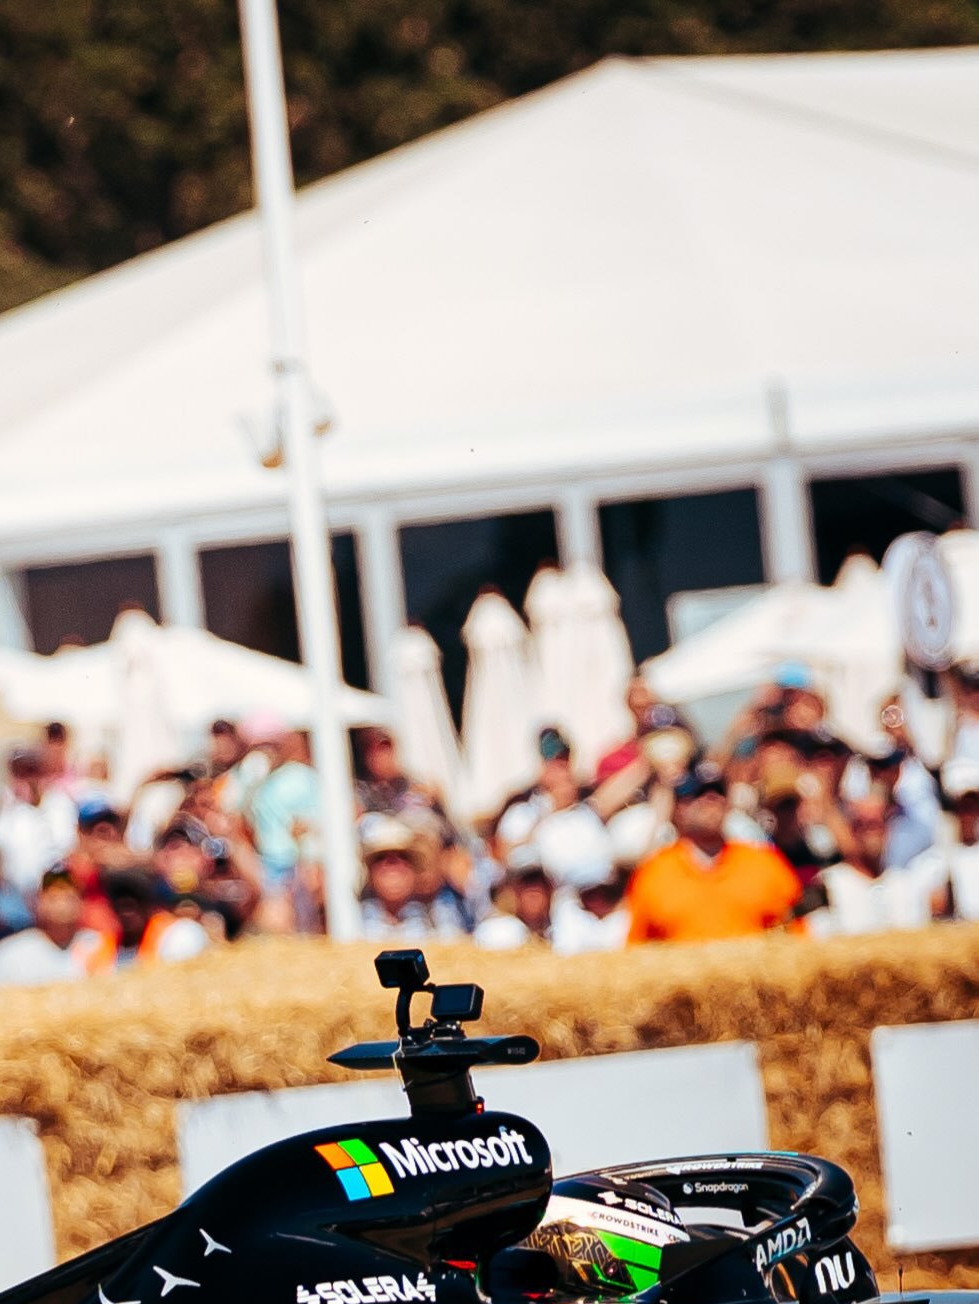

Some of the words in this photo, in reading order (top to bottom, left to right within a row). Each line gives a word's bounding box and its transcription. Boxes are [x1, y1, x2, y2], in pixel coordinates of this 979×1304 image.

[378, 1125, 533, 1179] Microsoft
[694, 1182, 749, 1194] Snapdragon
[591, 1211, 659, 1238] CROWDSTRIKE
[755, 1227, 797, 1273] AMD
